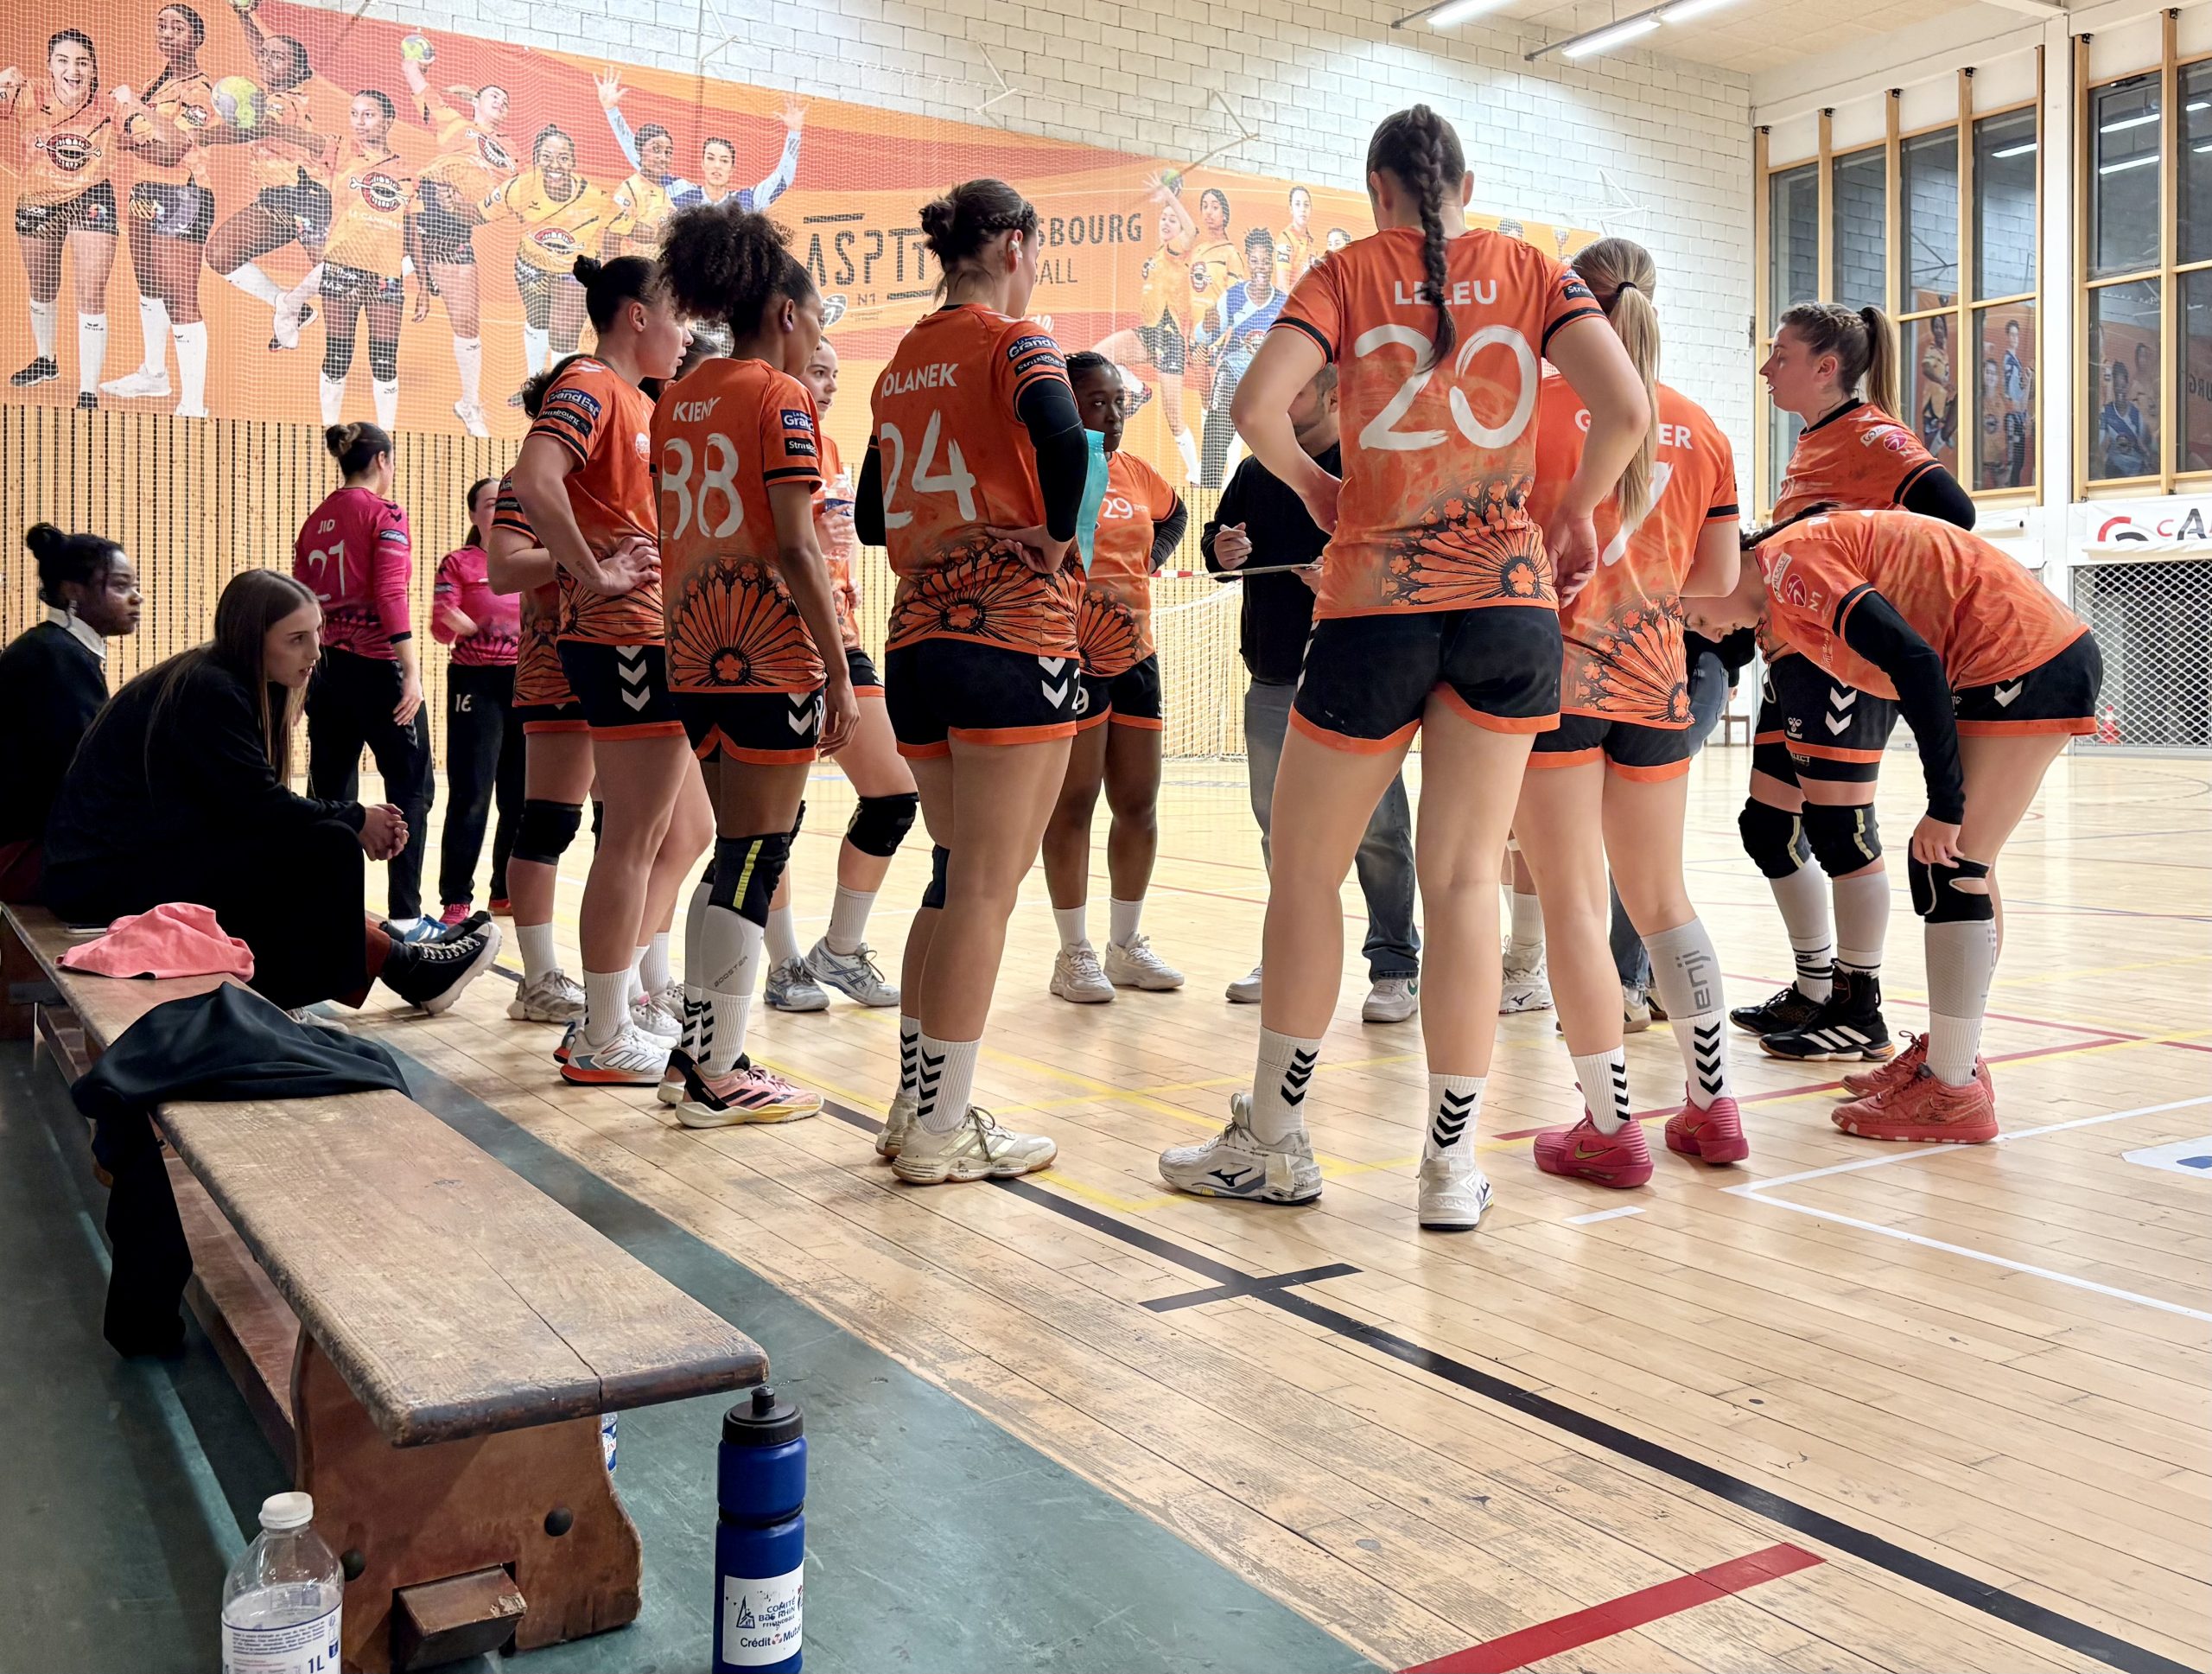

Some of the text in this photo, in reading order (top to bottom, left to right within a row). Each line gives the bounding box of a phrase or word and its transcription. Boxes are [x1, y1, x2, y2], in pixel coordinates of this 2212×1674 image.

[1395, 279, 1497, 305] LEEU
[1354, 323, 1538, 451] 20
[672, 396, 721, 423] KIENY
[880, 408, 976, 529] 24
[661, 433, 745, 540] 88
[1103, 497, 1134, 519] 29
[740, 1637, 771, 1648] Crédit
[308, 1654, 325, 1674] 1L
